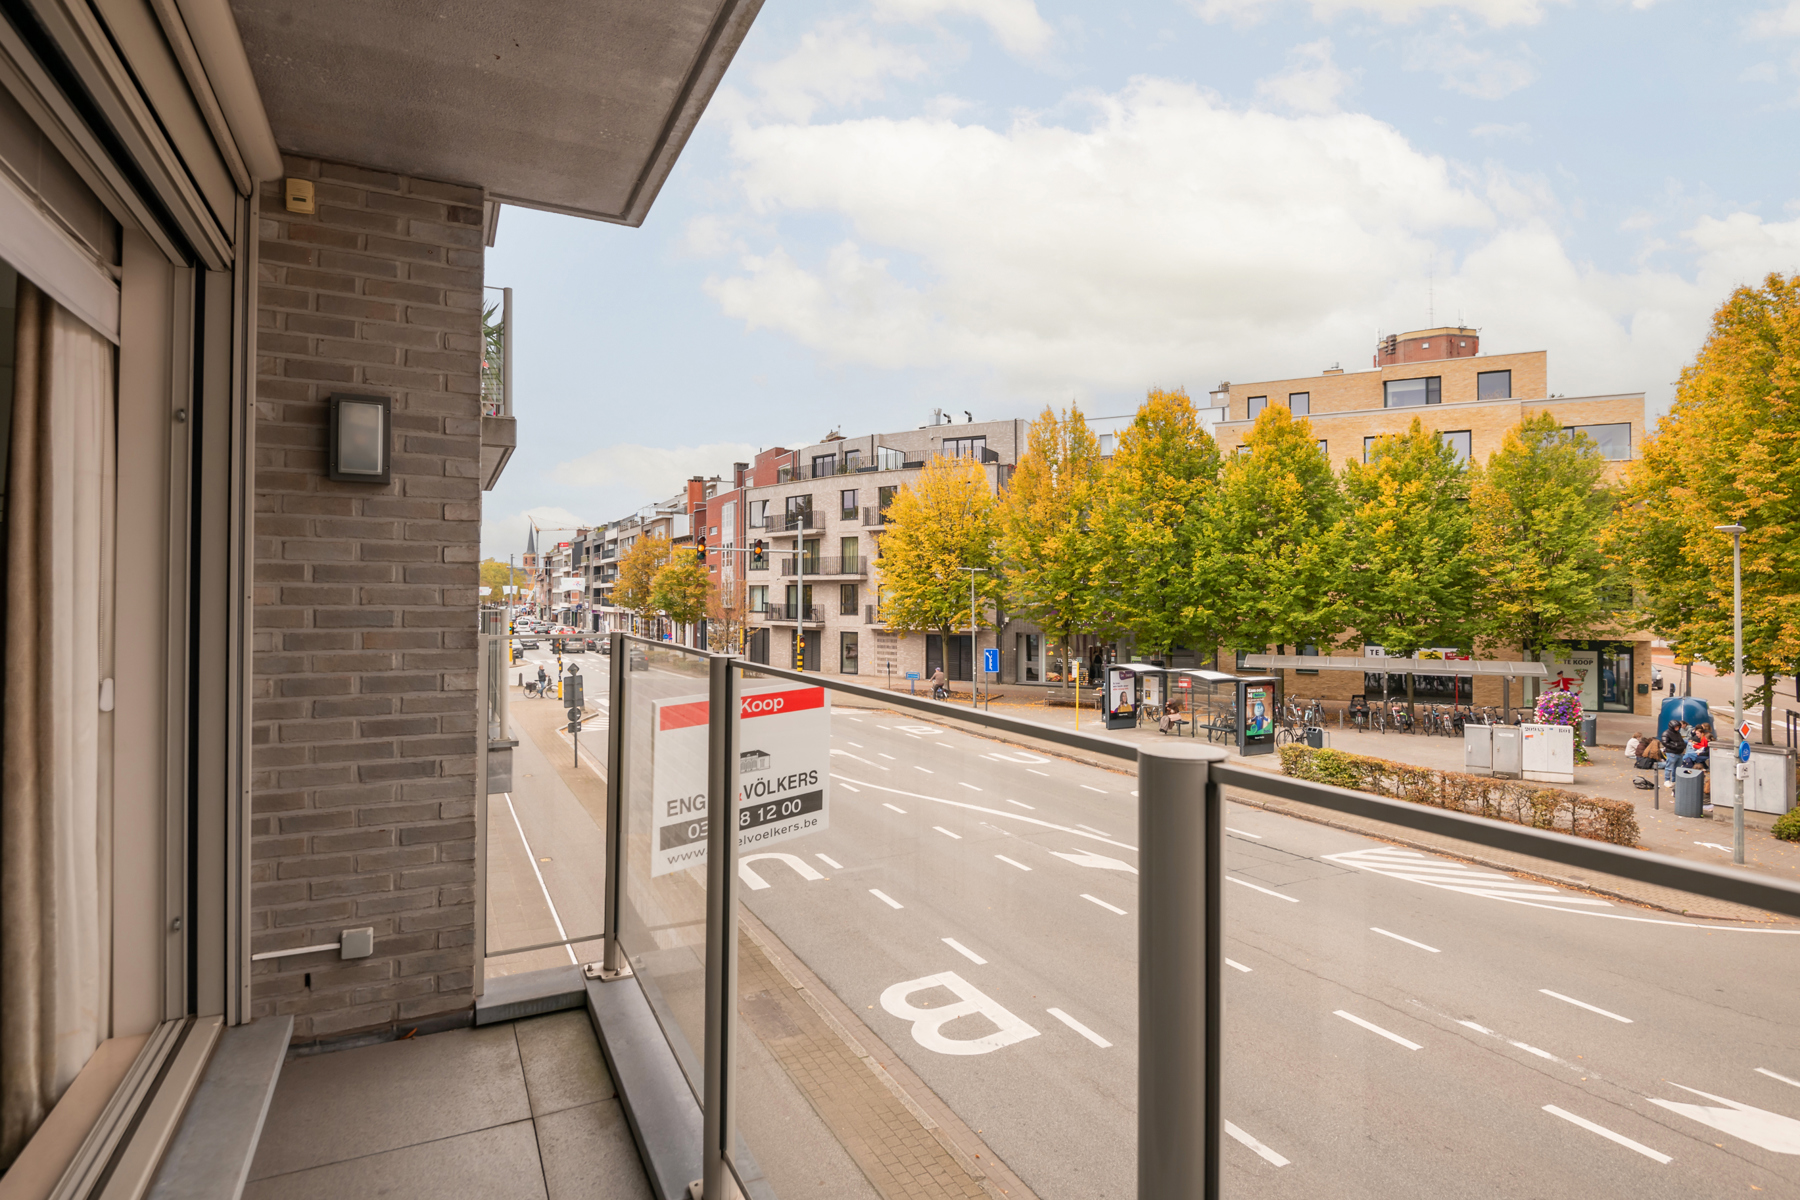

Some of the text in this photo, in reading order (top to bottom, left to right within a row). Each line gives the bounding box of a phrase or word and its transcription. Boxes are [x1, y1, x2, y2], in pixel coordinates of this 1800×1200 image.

[741, 697, 784, 714] Koop
[667, 769, 819, 818] ENG VÖLKERS
[757, 804, 777, 822] 12
[781, 798, 802, 816] 00
